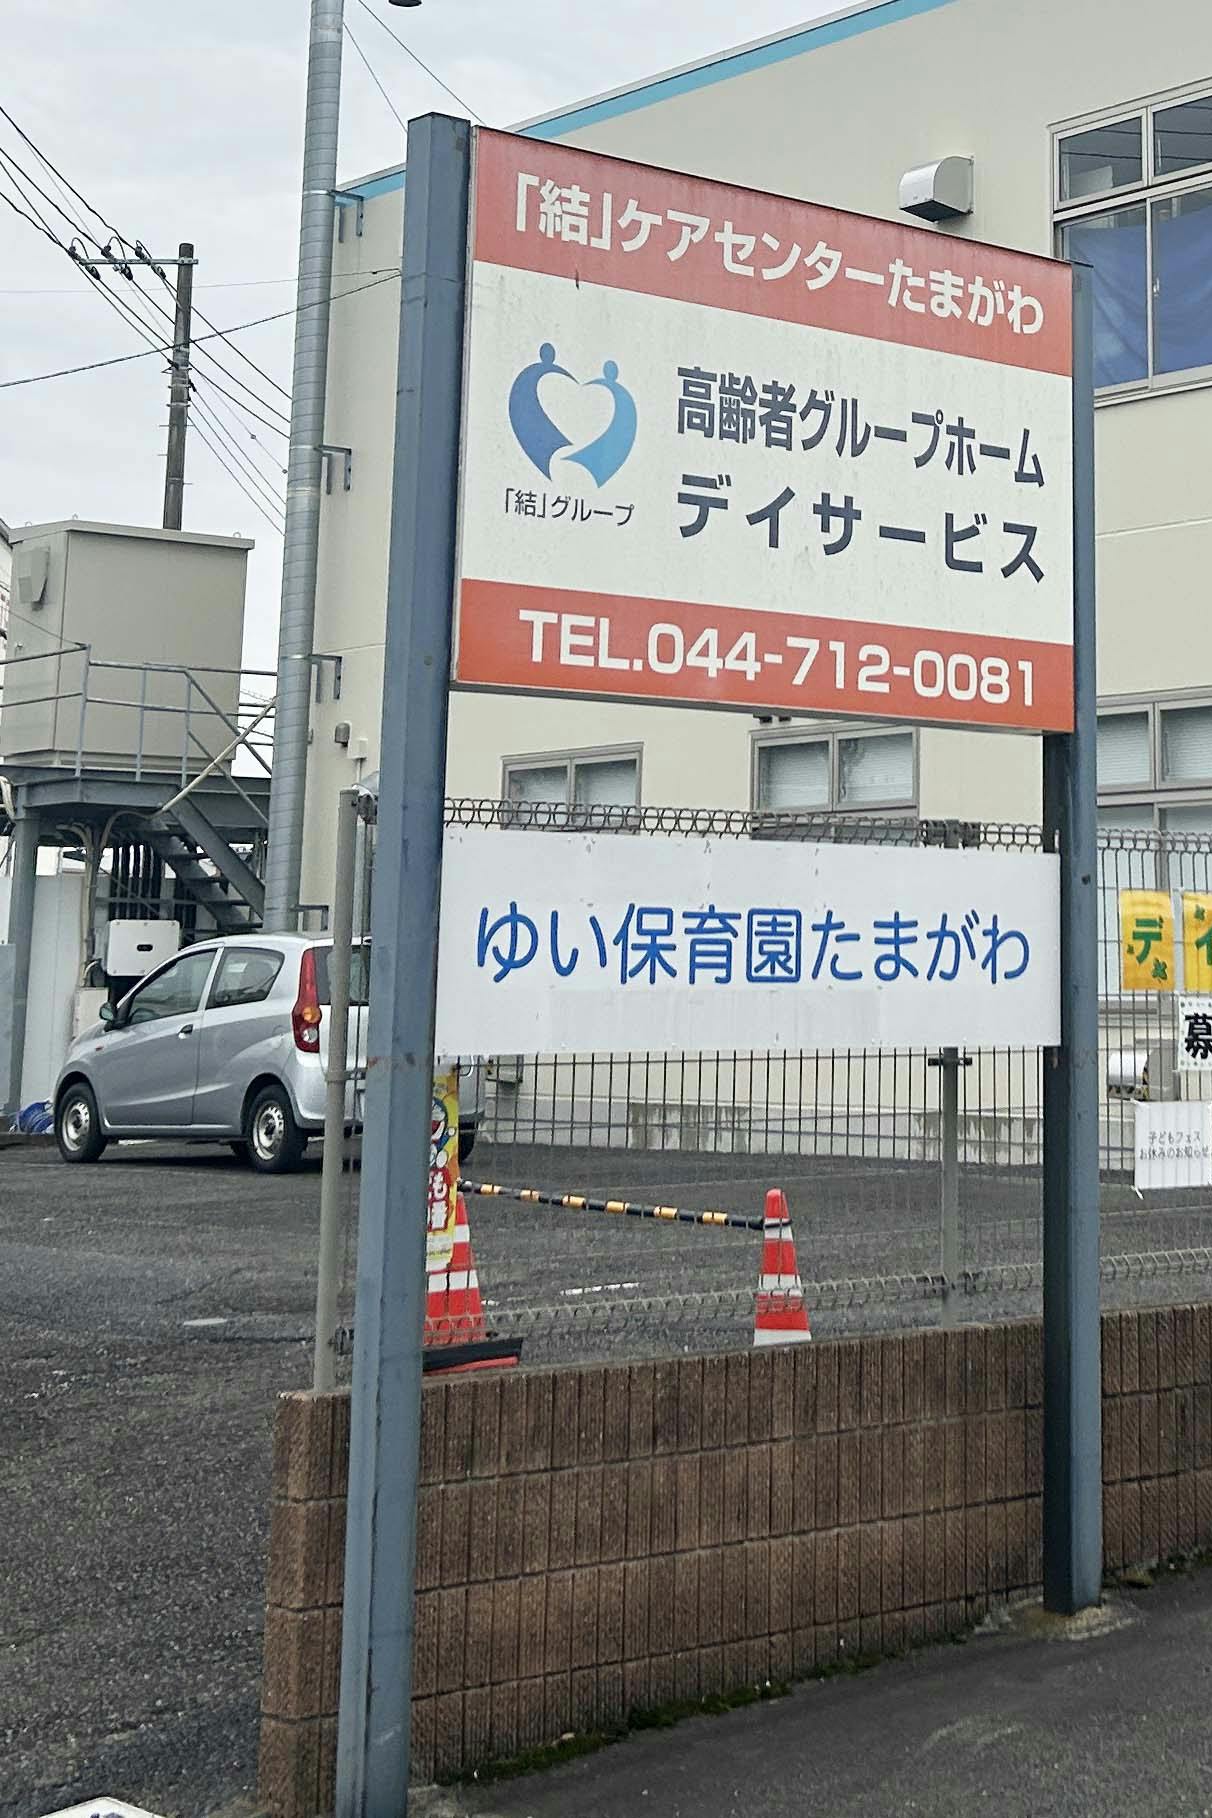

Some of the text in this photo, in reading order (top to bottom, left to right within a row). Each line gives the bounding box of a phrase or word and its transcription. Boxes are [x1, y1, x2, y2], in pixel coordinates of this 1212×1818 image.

[516, 172, 1044, 335] 「結」ケアセンターたまがわ
[677, 366, 1045, 488] 高齢者グループホーム
[505, 488, 635, 526] 「結」グループ
[677, 472, 1045, 583] デイサービス
[519, 609, 1034, 706] TEL.044-712-0081
[477, 900, 1031, 985] ゆい保育園たまがわ
